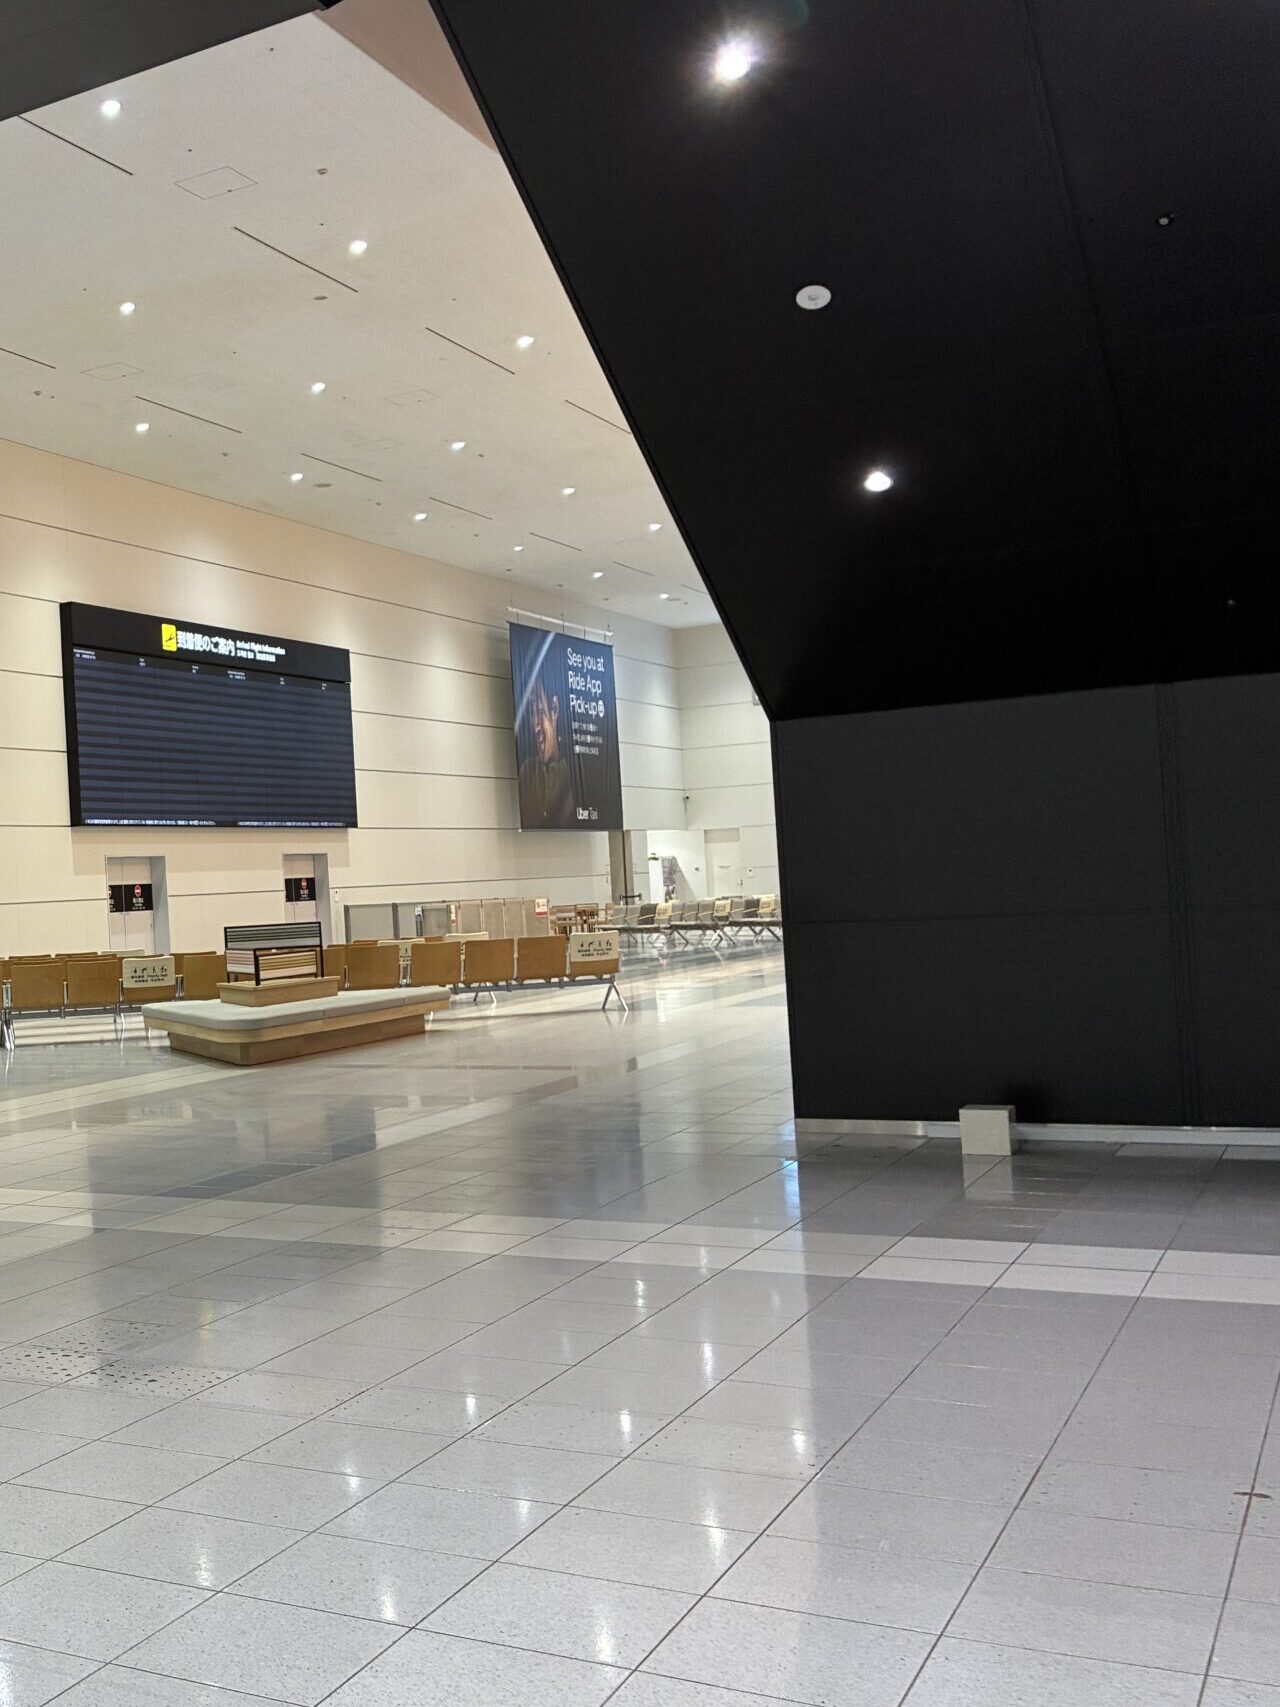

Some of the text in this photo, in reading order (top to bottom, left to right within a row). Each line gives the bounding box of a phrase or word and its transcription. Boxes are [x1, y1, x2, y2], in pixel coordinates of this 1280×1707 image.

[567, 647, 605, 673] See you at
[568, 670, 602, 698] Ride App
[570, 694, 597, 719] Pick-up
[576, 806, 589, 820] Uber
